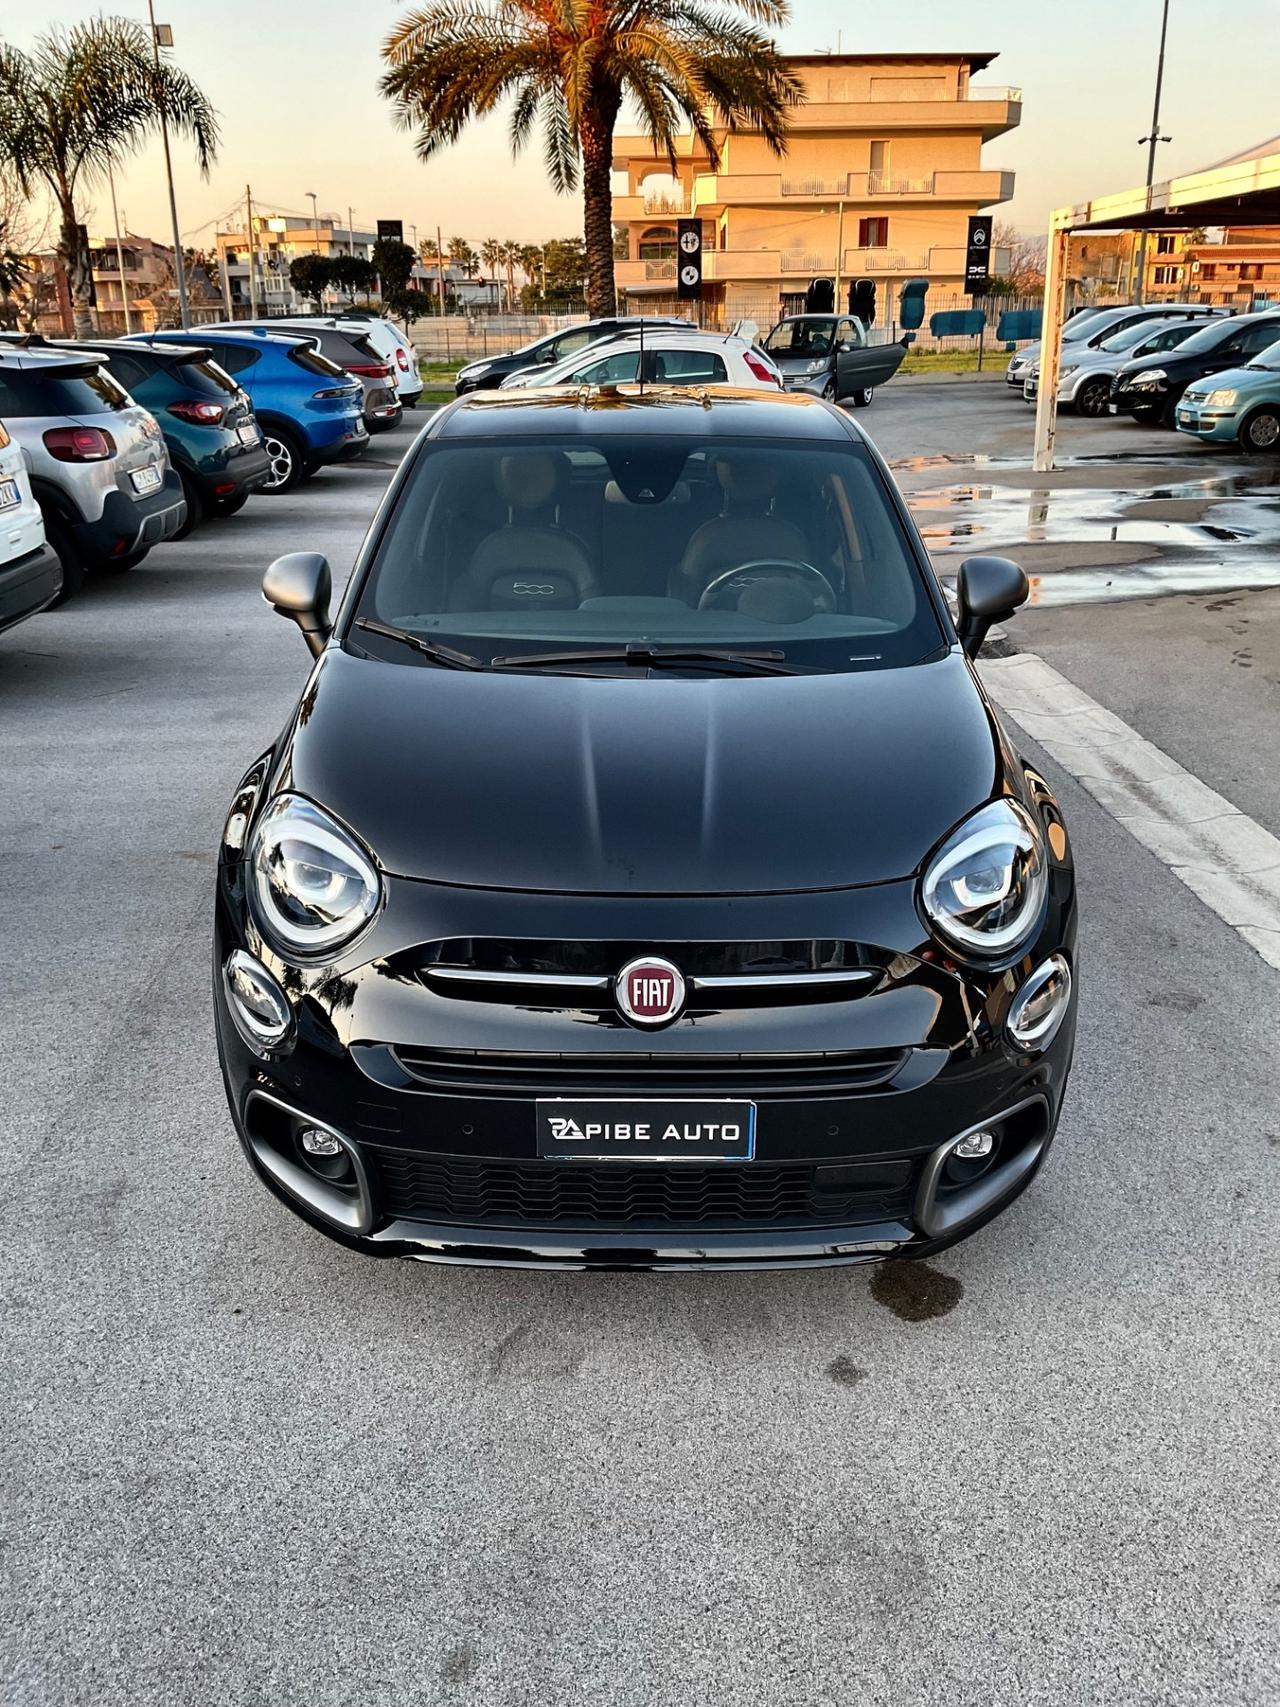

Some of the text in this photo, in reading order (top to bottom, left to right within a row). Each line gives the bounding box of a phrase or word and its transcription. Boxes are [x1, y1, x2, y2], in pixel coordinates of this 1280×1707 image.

[513, 582, 554, 595] 500
[633, 978, 671, 1007] FIAT
[662, 1123, 740, 1140] AUTO
